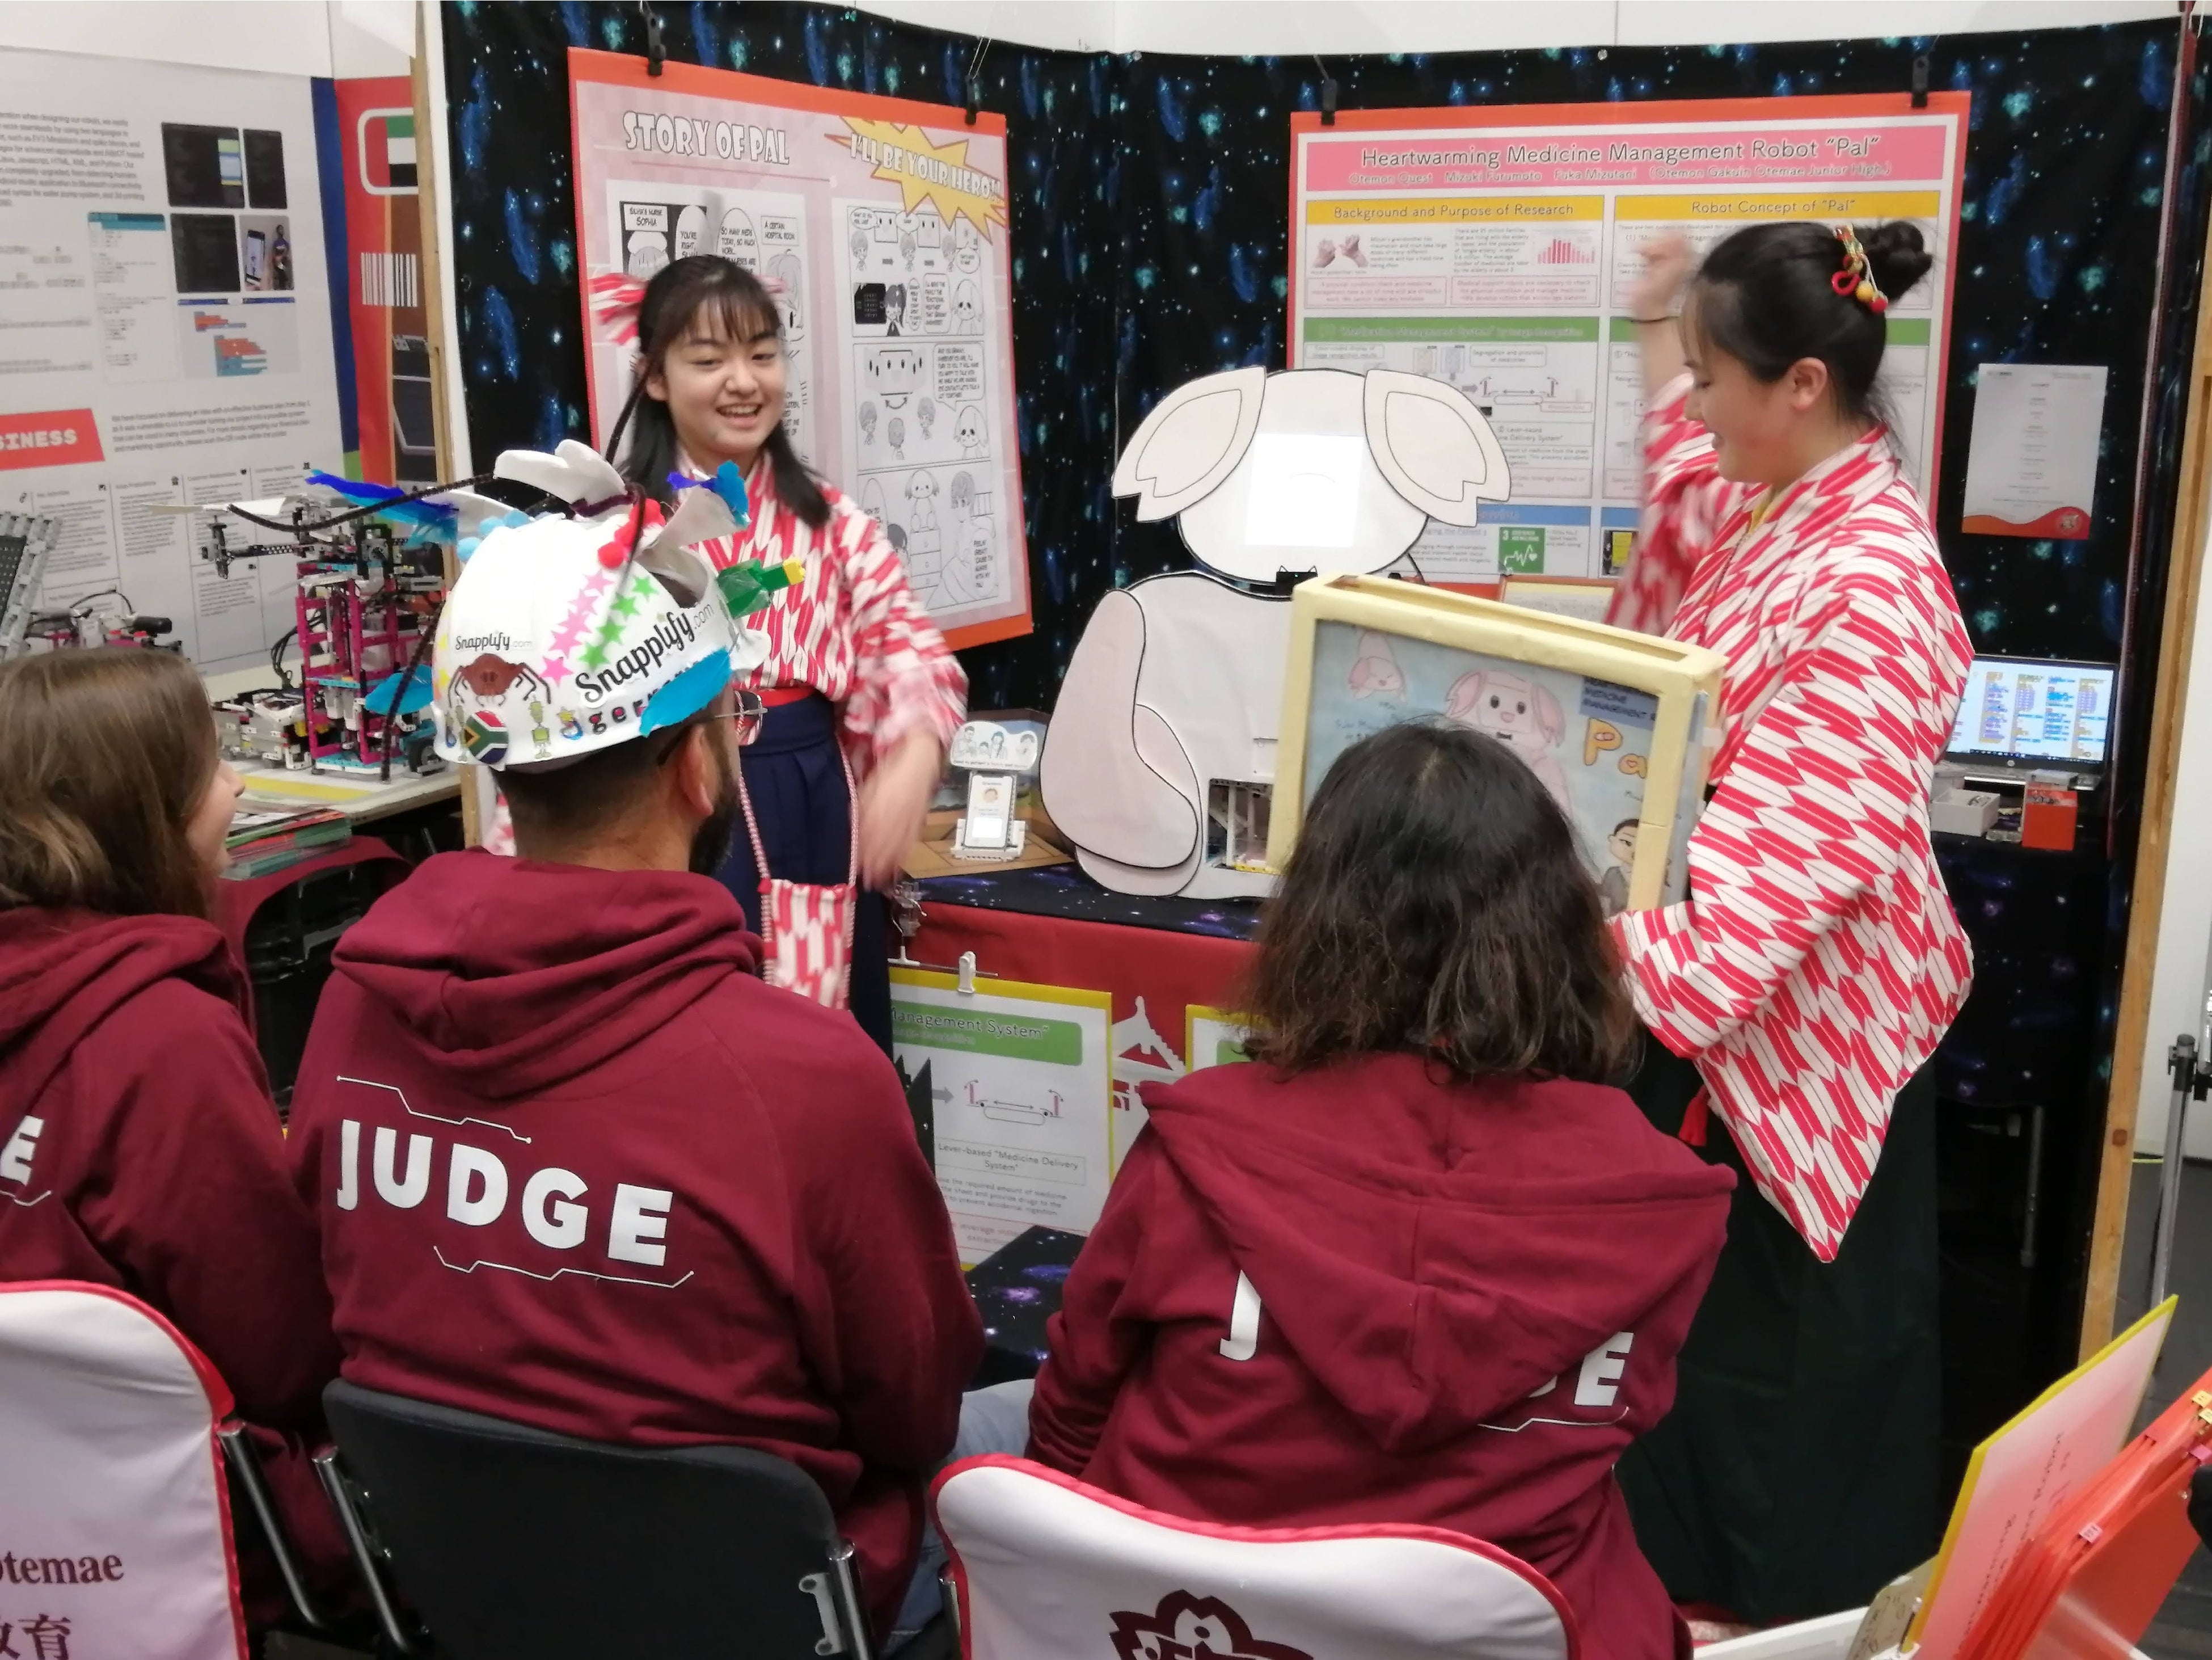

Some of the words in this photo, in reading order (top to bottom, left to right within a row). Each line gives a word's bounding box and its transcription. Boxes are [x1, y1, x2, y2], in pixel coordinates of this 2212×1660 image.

[623, 111, 710, 157] STORY
[716, 121, 745, 159] OF
[749, 125, 790, 165] PAL
[1362, 146, 1500, 168] Heartwarming
[1506, 143, 1601, 164] Medicine
[1609, 142, 1744, 165] Management
[1752, 138, 1818, 159] Robot
[850, 132, 880, 165] I'LL
[883, 142, 904, 172] BE
[906, 149, 949, 187] YOUR
[1399, 171, 1433, 186] Quest
[1445, 171, 1483, 183] Mizuki
[1334, 205, 1408, 221] Background
[1413, 205, 1435, 217] and
[1441, 204, 1492, 220] Purpose
[1496, 204, 1510, 215] of
[1514, 203, 1574, 215] Research
[1692, 201, 1732, 214] Robot
[1739, 200, 1797, 216] Concept
[1802, 199, 1816, 212] of
[454, 631, 534, 652] Snapplify.com
[575, 601, 715, 703] Snapplify.com
[938, 1143, 991, 1158] Lever-based
[1042, 1157, 1078, 1170] Delivery
[336, 1118, 674, 1267] JUDGE
[0, 1551, 124, 1584] temae
